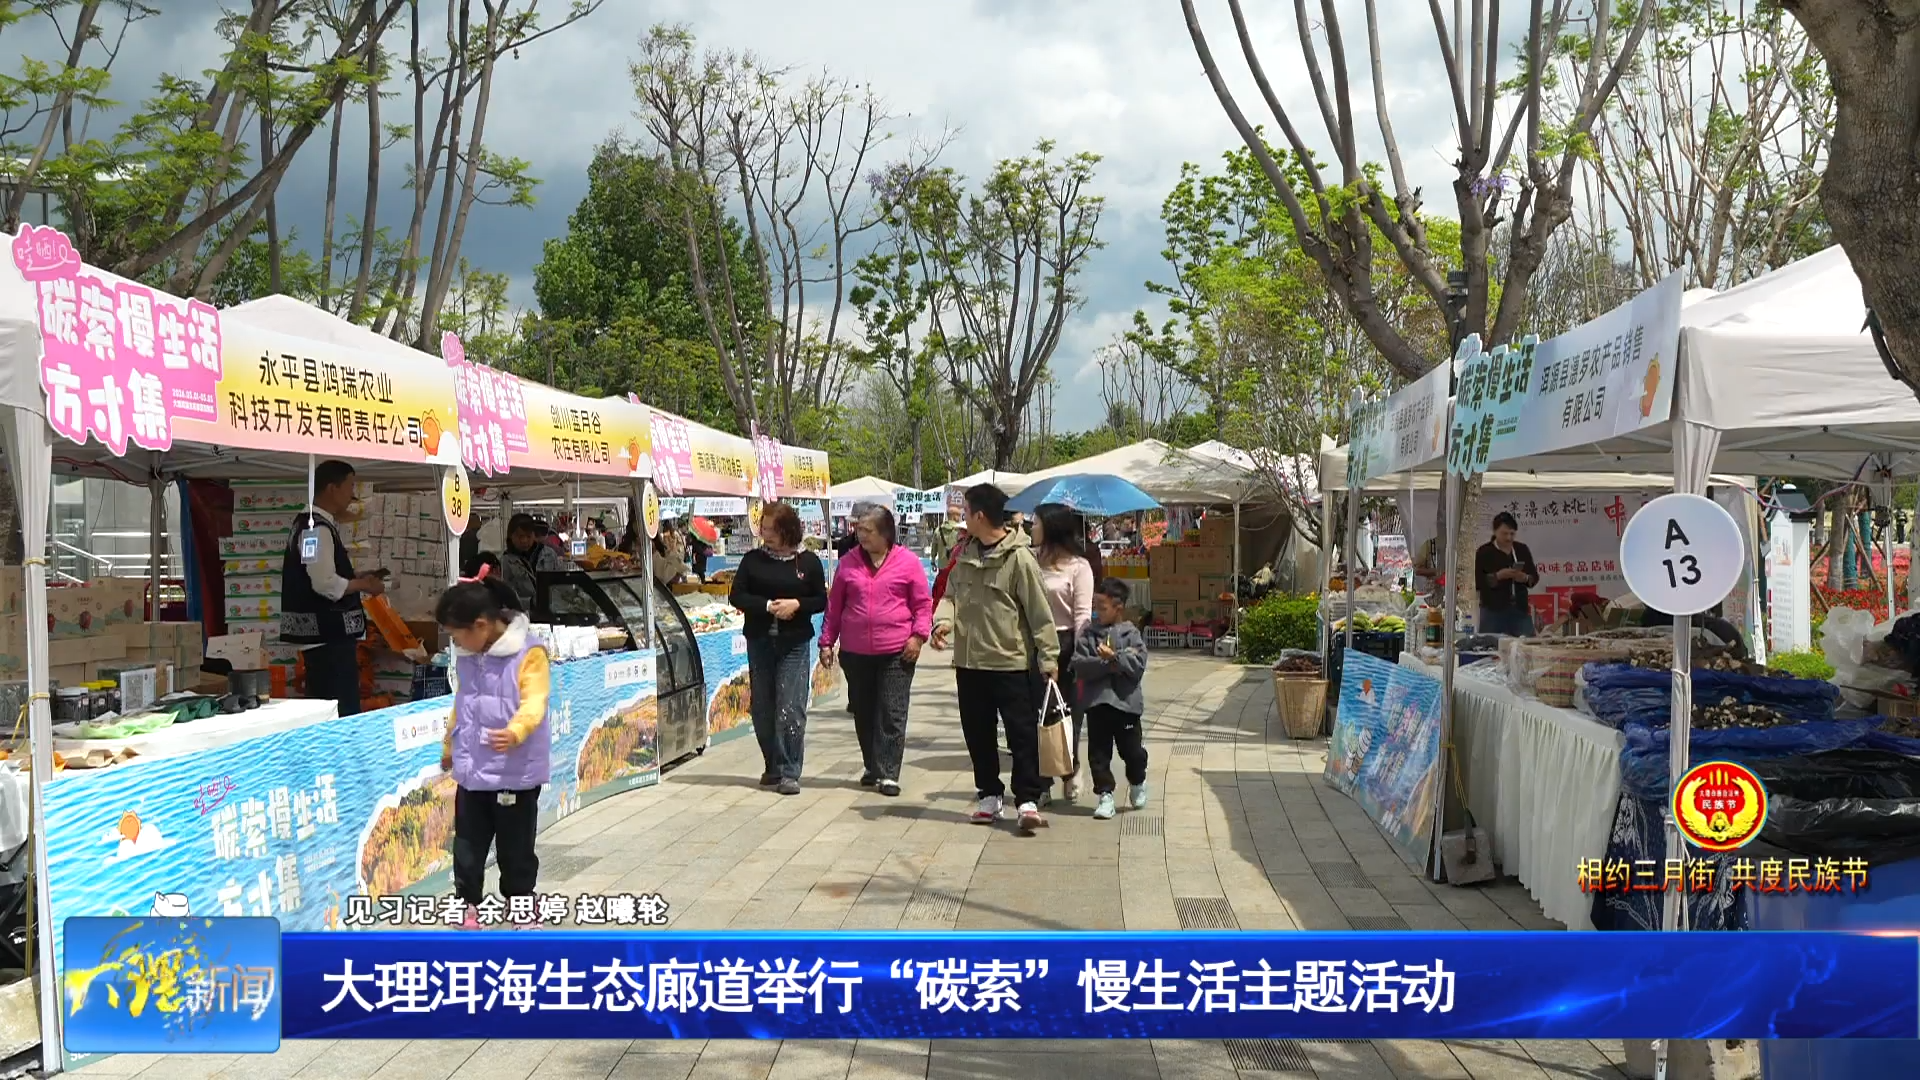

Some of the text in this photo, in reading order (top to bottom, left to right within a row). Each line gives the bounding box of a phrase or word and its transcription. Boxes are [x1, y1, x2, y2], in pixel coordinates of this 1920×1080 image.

[41, 280, 220, 373] 碳索慢生活
[259, 350, 393, 404] 永平县鸿瑞农业
[47, 364, 168, 445] 方寸集
[228, 391, 423, 449] 科技开发有限责任公司
[1562, 386, 1606, 429] 有限公司
[551, 436, 611, 465] 农庄有限公司
[1449, 412, 1495, 472] 方寸集
[451, 496, 462, 518] 38
[454, 474, 460, 492] B
[1664, 518, 1690, 550] A
[1662, 554, 1702, 588] 13
[211, 773, 339, 861] 碳索慢生活
